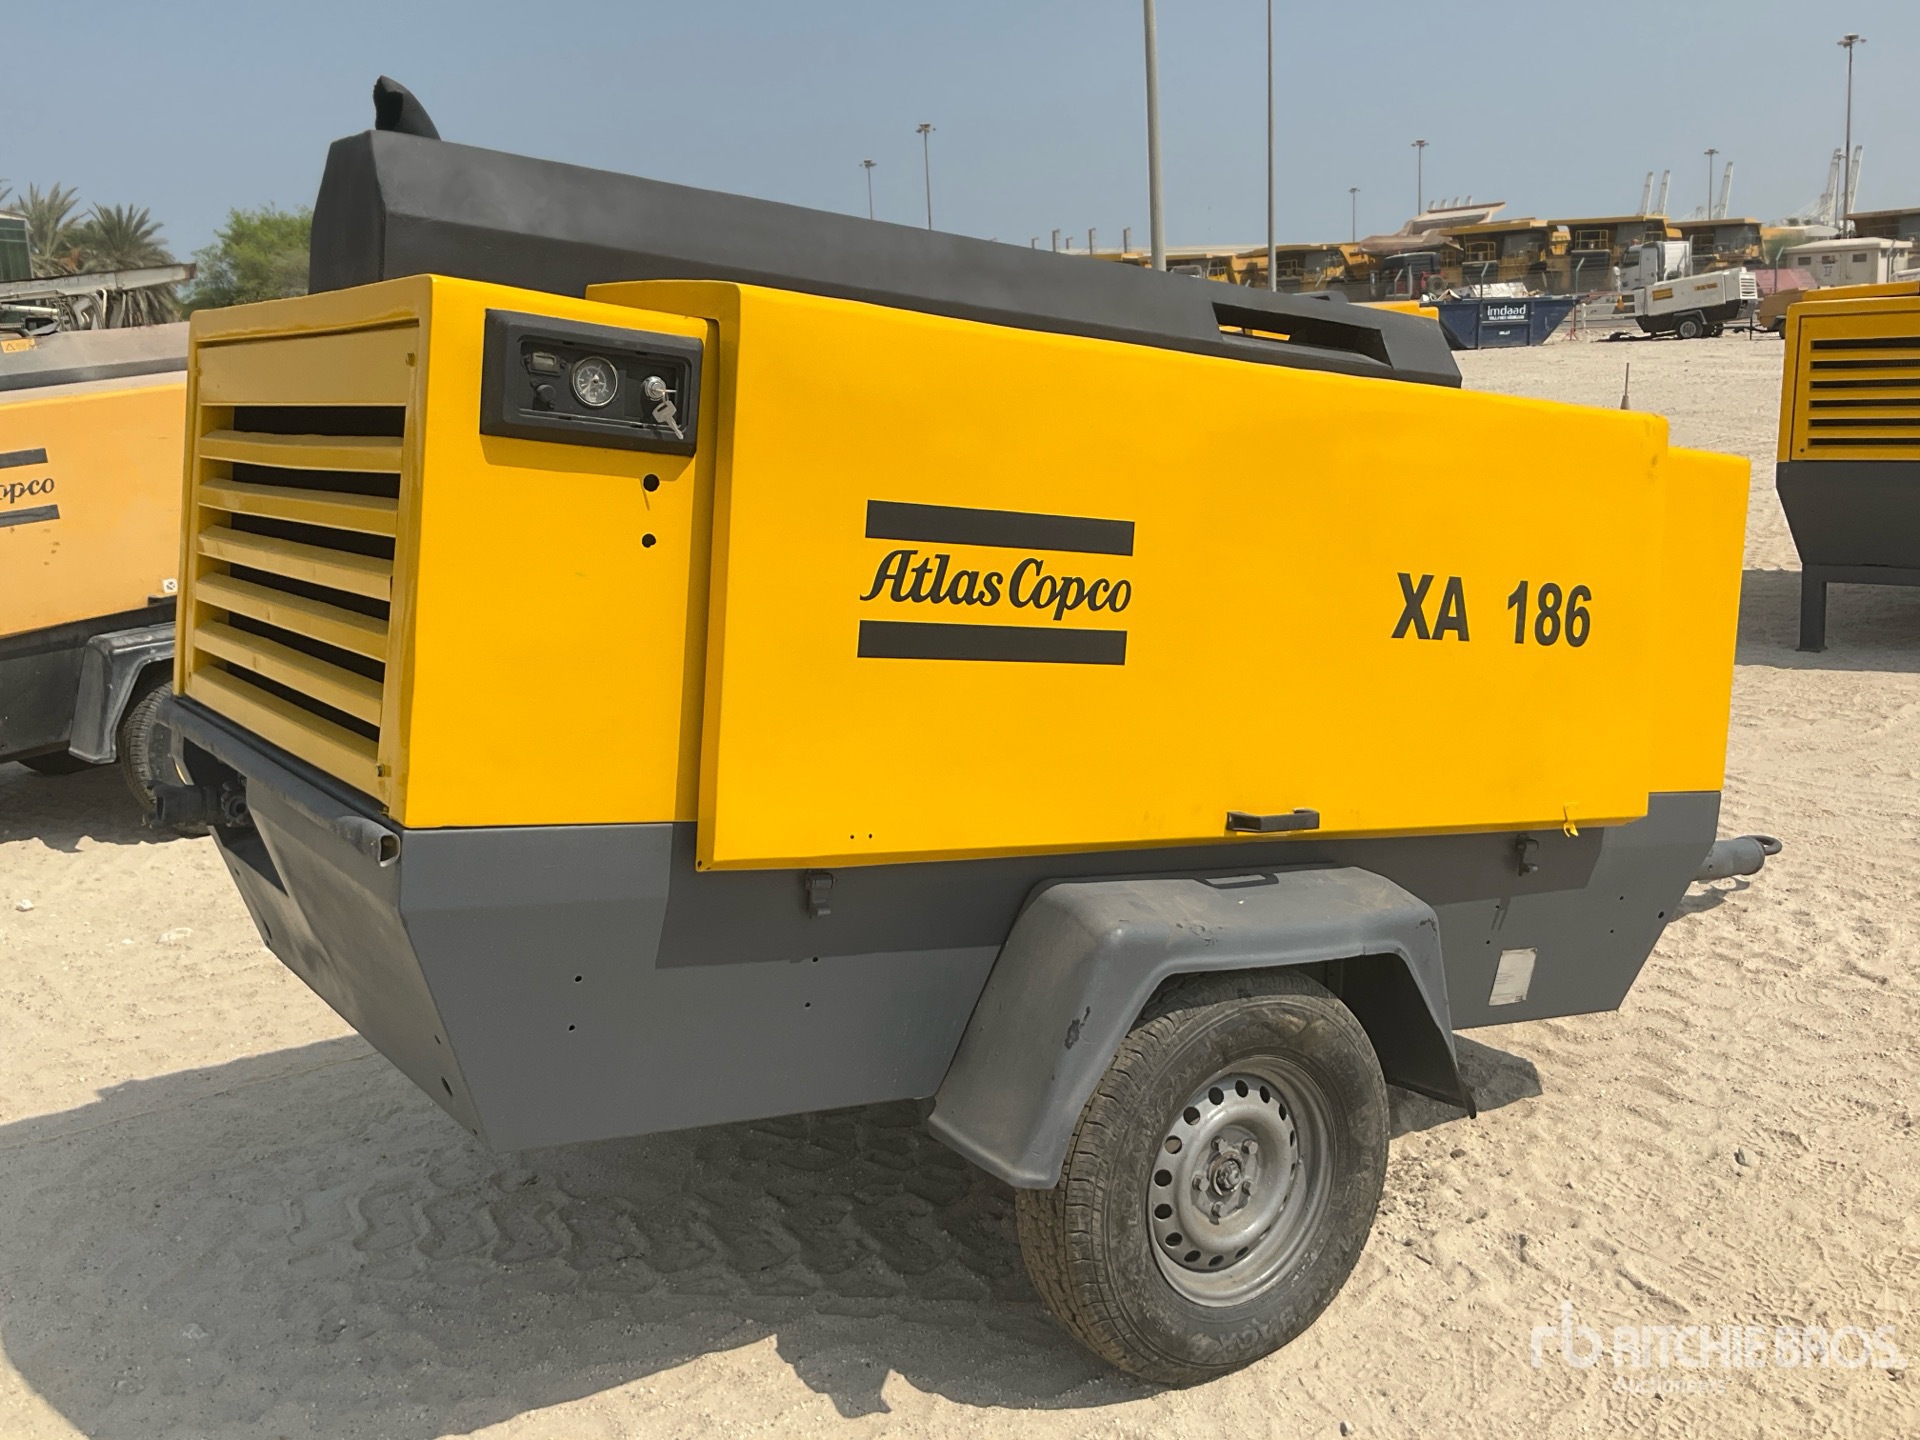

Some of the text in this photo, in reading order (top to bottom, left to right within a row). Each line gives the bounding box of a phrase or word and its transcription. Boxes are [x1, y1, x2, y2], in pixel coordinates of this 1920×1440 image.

[1487, 304, 1527, 317] Imdaad
[860, 549, 1132, 621] Atlas Copco
[1391, 572, 1592, 648] XA 186
